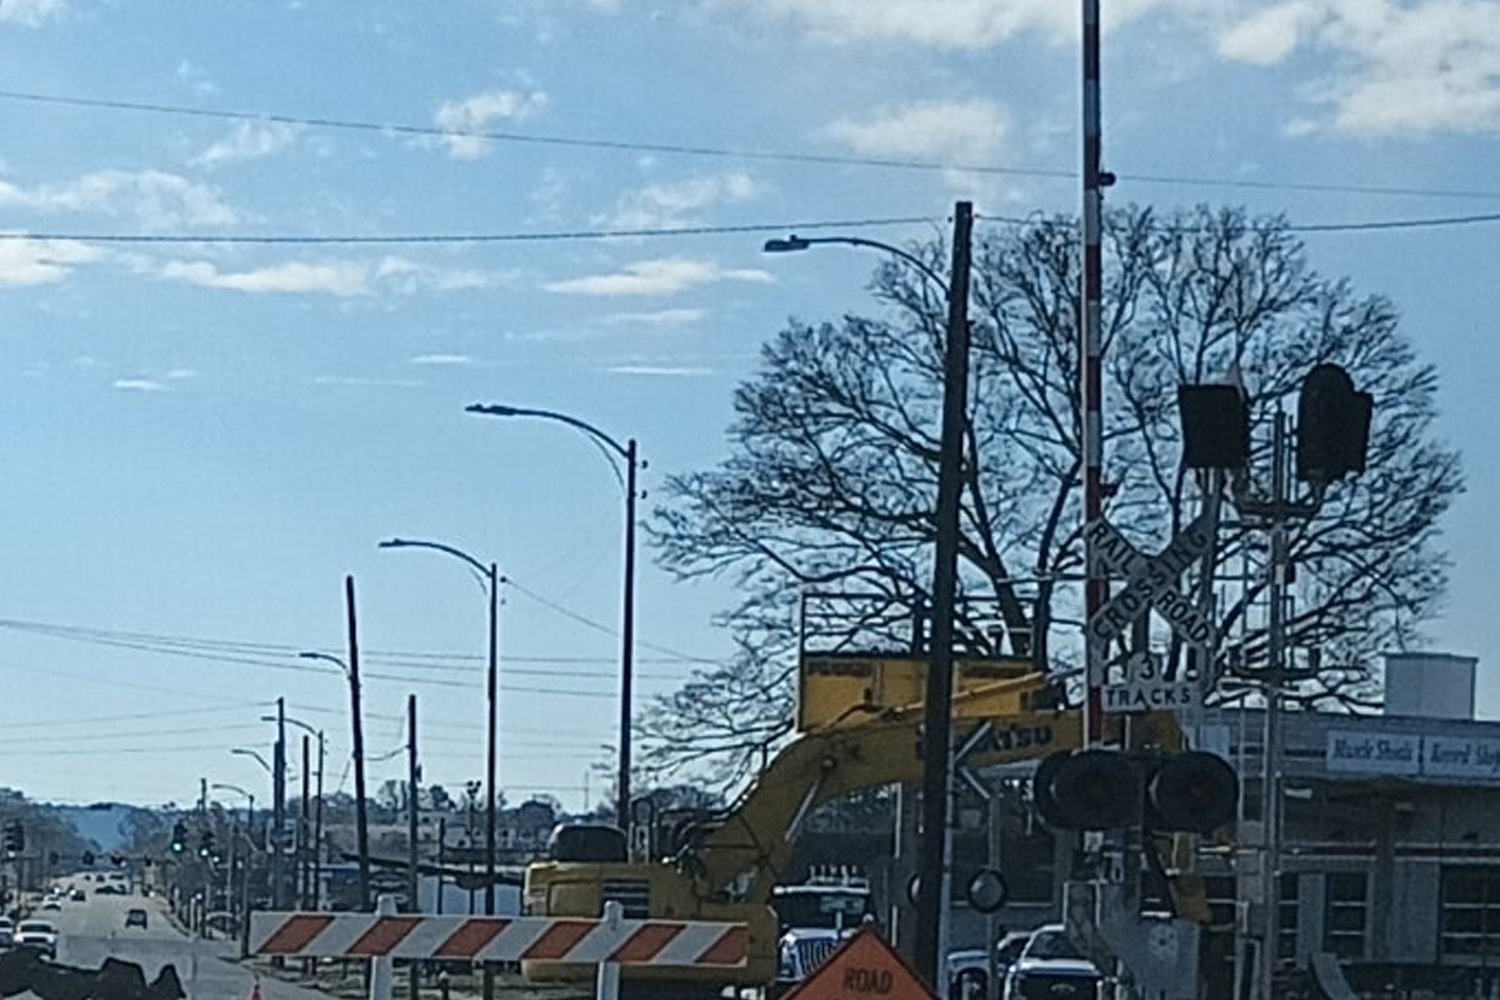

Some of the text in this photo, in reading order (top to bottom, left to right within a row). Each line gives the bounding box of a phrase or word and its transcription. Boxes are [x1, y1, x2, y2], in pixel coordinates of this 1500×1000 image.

[1090, 522, 1209, 642] RAIL ROAD
[1093, 531, 1207, 639] CROSSING
[1138, 656, 1155, 680] 3
[1105, 686, 1191, 707] TRACKS
[844, 968, 893, 995] ROAD
